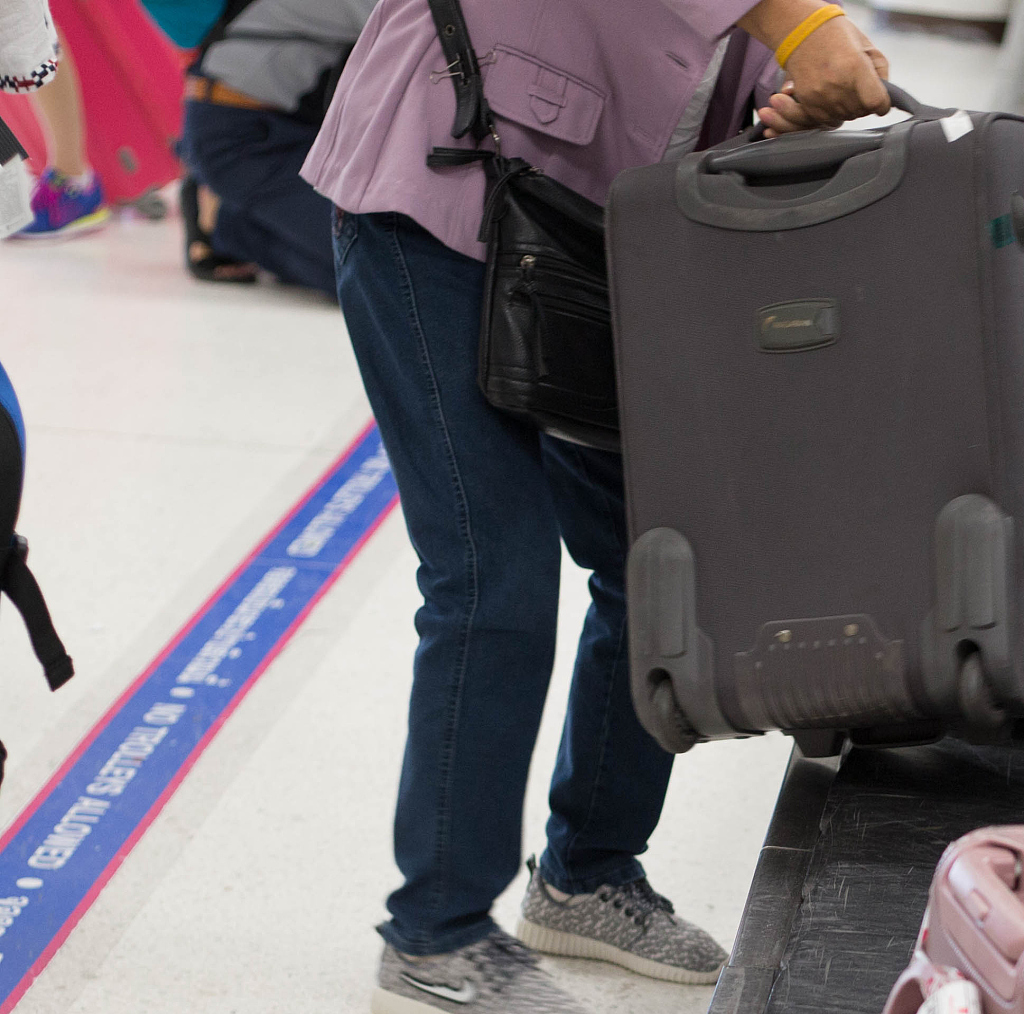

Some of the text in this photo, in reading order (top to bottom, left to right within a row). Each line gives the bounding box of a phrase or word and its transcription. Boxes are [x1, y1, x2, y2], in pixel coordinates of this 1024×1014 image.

[28, 702, 187, 870] NO TROLLEYS ALLOWED
